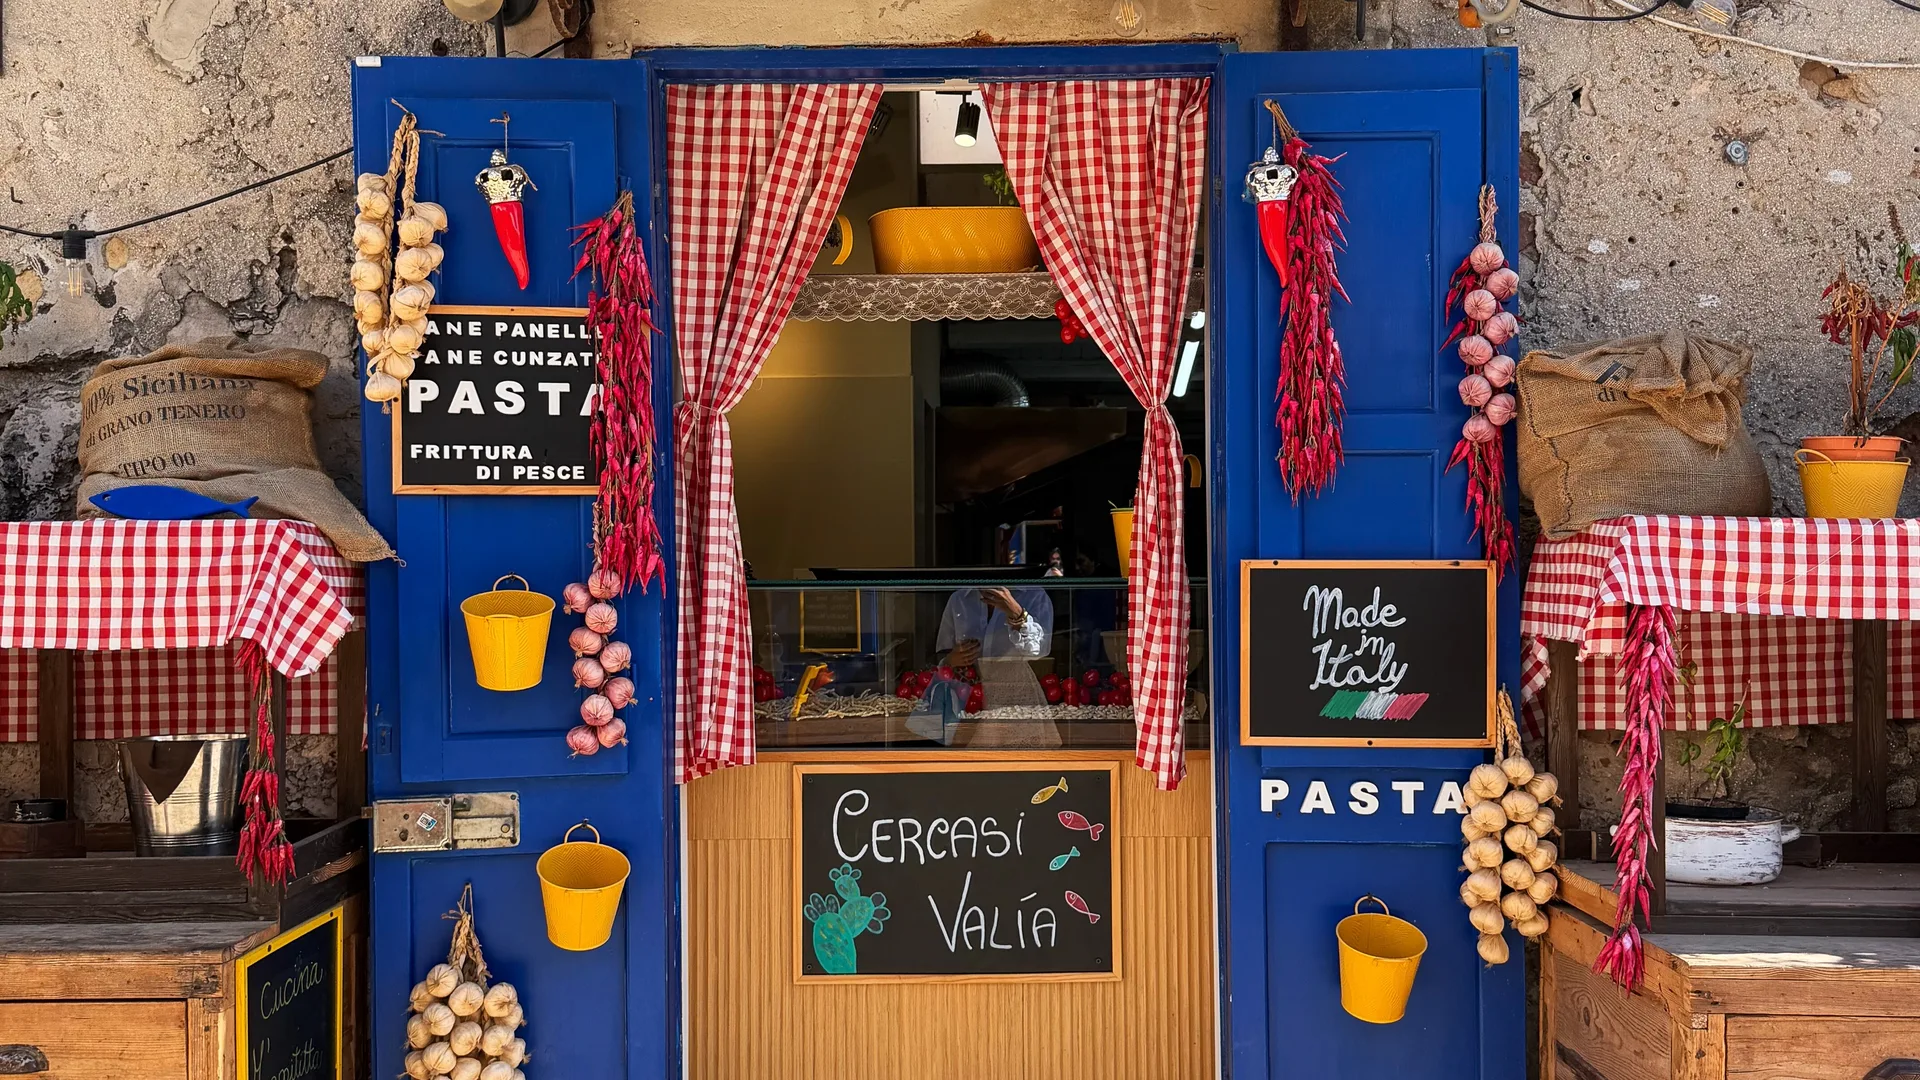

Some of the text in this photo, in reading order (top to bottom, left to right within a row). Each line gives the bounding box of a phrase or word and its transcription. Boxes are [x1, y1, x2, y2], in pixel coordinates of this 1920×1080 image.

[424, 320, 482, 337] ANE
[424, 349, 482, 365] ANE
[98, 410, 152, 442] GRANO
[157, 404, 247, 422] TENERO
[410, 444, 533, 460] FRITTURA
[119, 456, 167, 478] TIPO
[476, 465, 586, 480] DI PESCE
[1303, 584, 1407, 639] Made
[1354, 628, 1384, 656] in
[1308, 638, 1409, 693] Italy
[1260, 779, 1469, 816] PASTA
[260, 961, 324, 1020] Cucina
